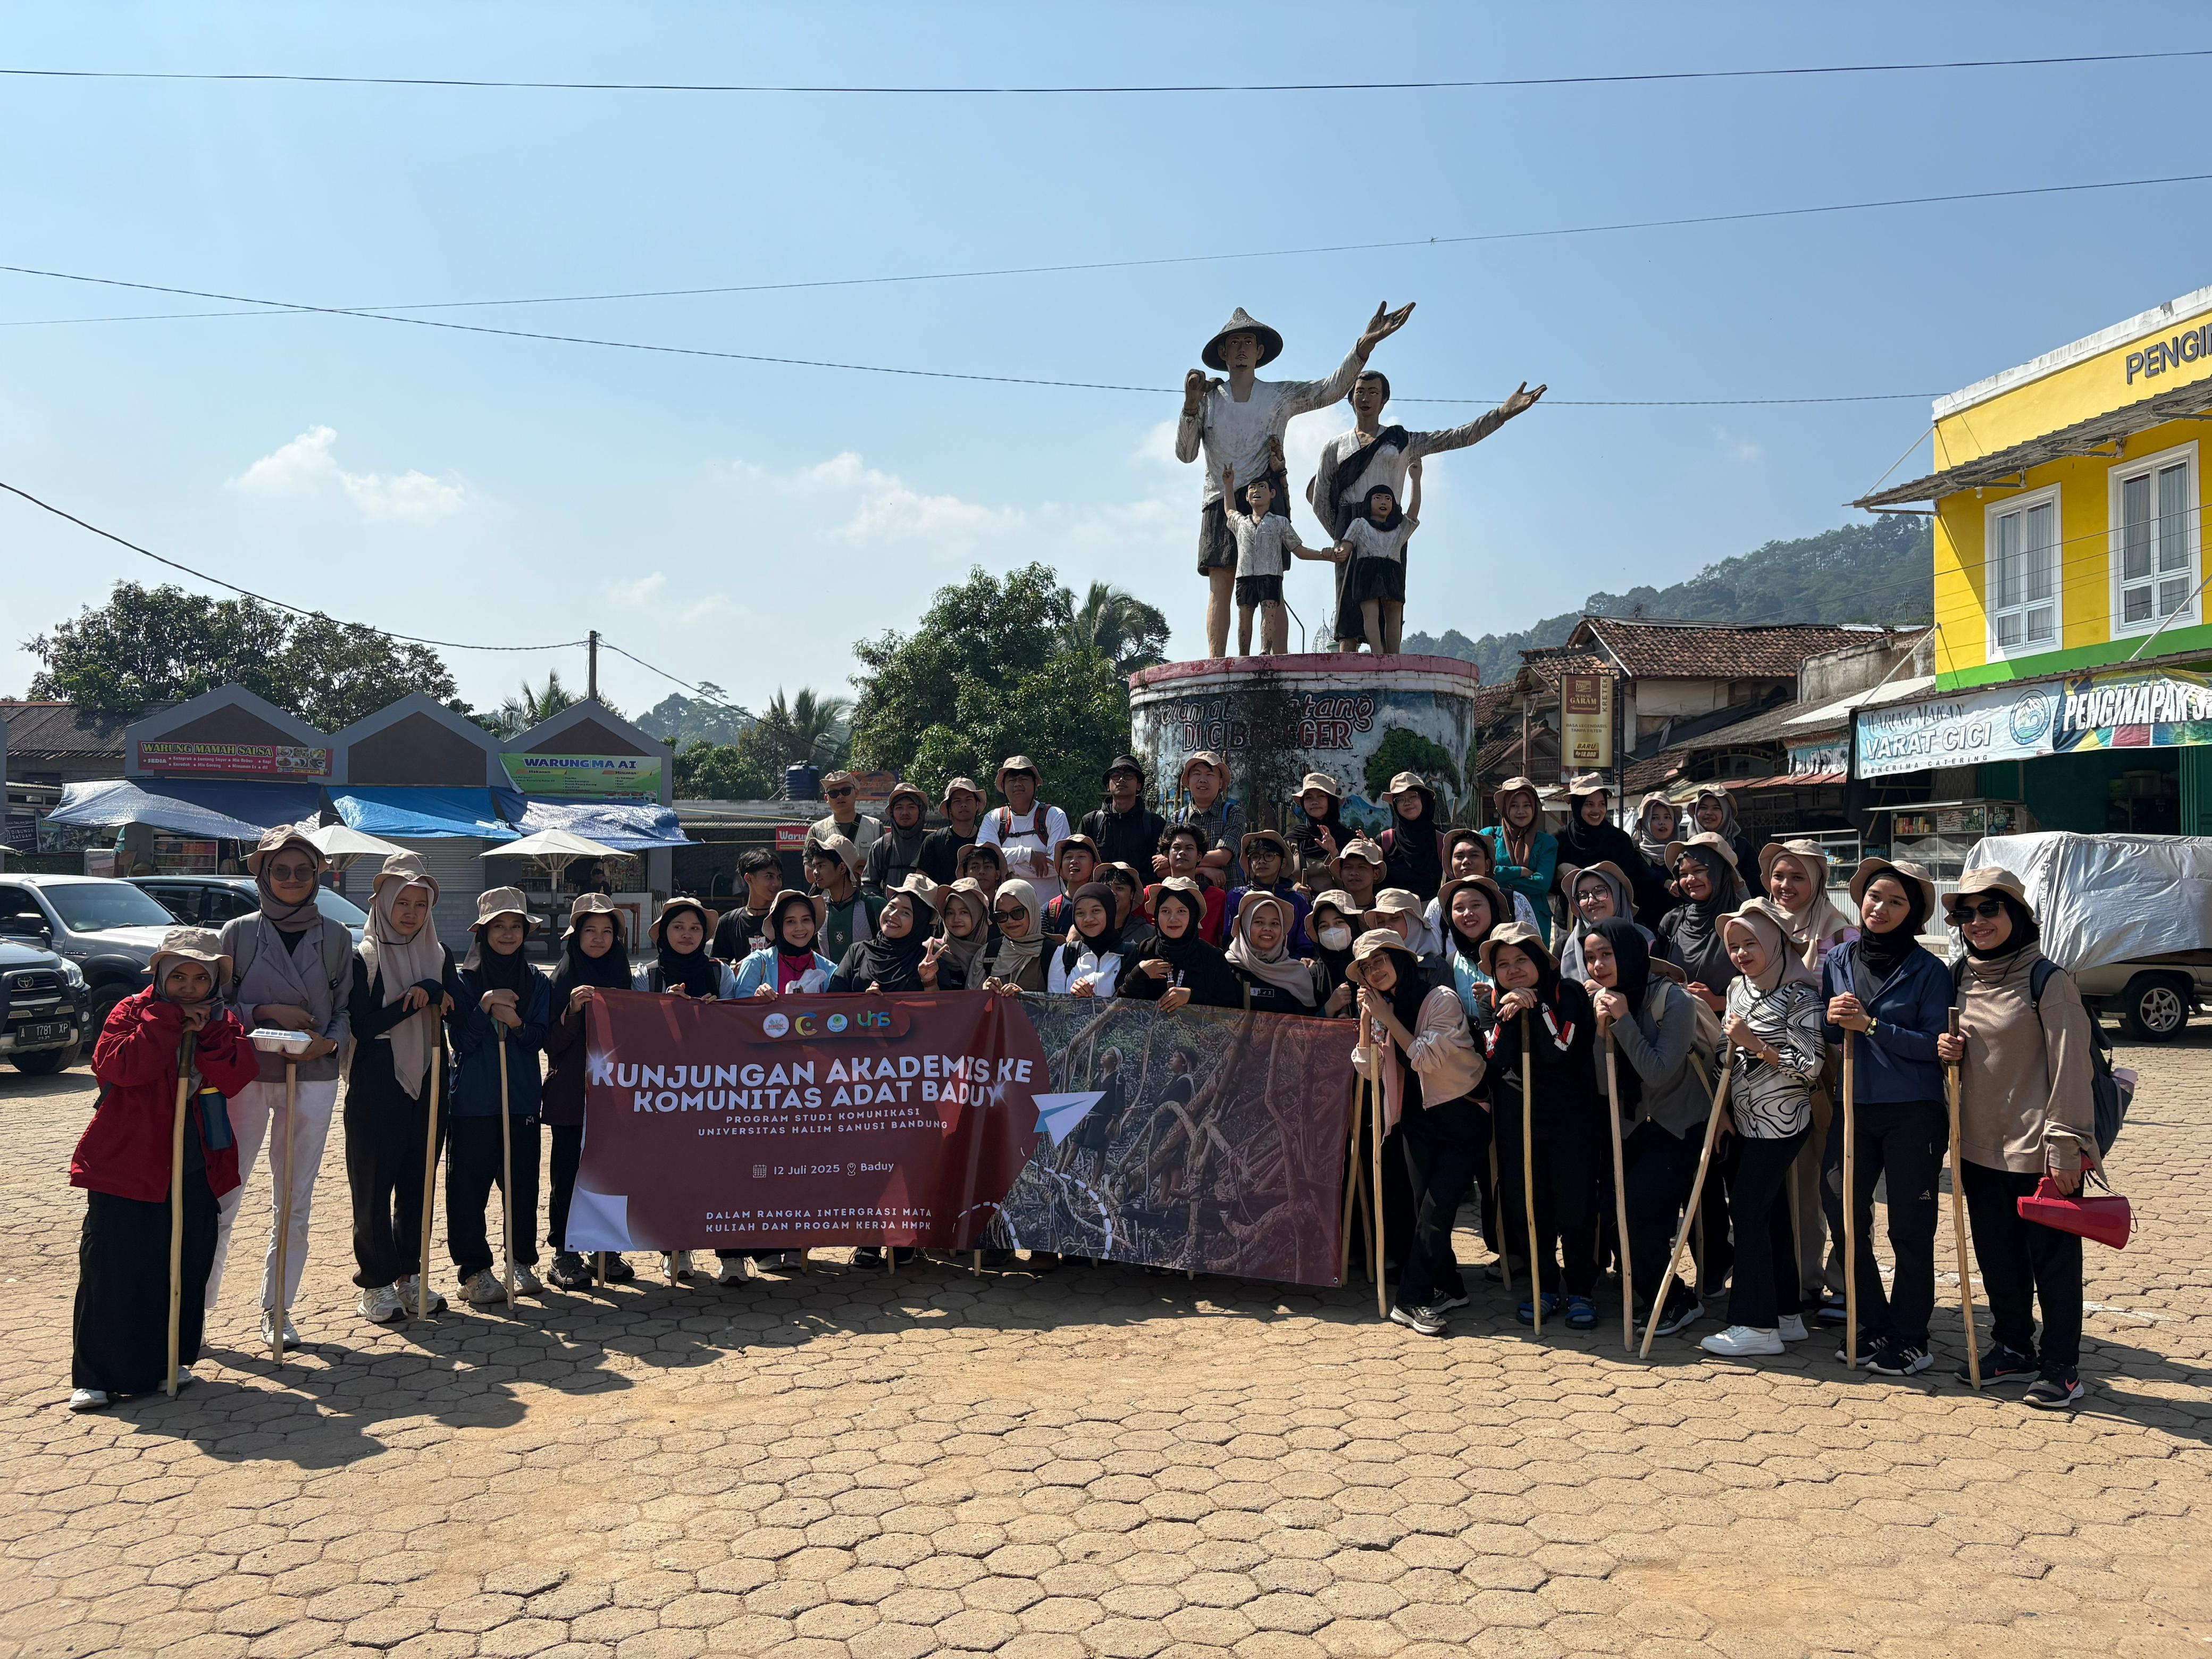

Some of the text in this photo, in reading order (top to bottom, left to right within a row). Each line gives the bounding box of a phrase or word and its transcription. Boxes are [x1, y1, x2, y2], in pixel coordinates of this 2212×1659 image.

[2063, 683, 2189, 732] PENGINAPAN
[1183, 718, 1354, 752] DI CIBEGER
[1865, 728, 1937, 760] VARAT
[1942, 722, 1992, 751] CICI
[142, 742, 273, 757] WARUNG MAMAH SALSA
[523, 758, 590, 768] WARUNG
[1863, 755, 1988, 775] MENERIMA CATERING
[21, 1023, 69, 1037] A 1781 XP
[591, 1054, 1033, 1089] KUNJUNGAN AKADEMIS KE
[633, 1080, 998, 1113] KOMUNITAS ADAT BADUY
[726, 1108, 920, 1124] PROGRAM STUDI KOMUNIKASI
[698, 1120, 948, 1137] UNIVERSITAS HALIM SANUSI BANDUNG
[774, 1161, 895, 1175] 12 Juli 2025 Baduy
[706, 1207, 932, 1220] DALAM RANGKA INTERGRASI MATA
[706, 1221, 931, 1233] KULIAH DAN PROGAM KERJA HMPK
